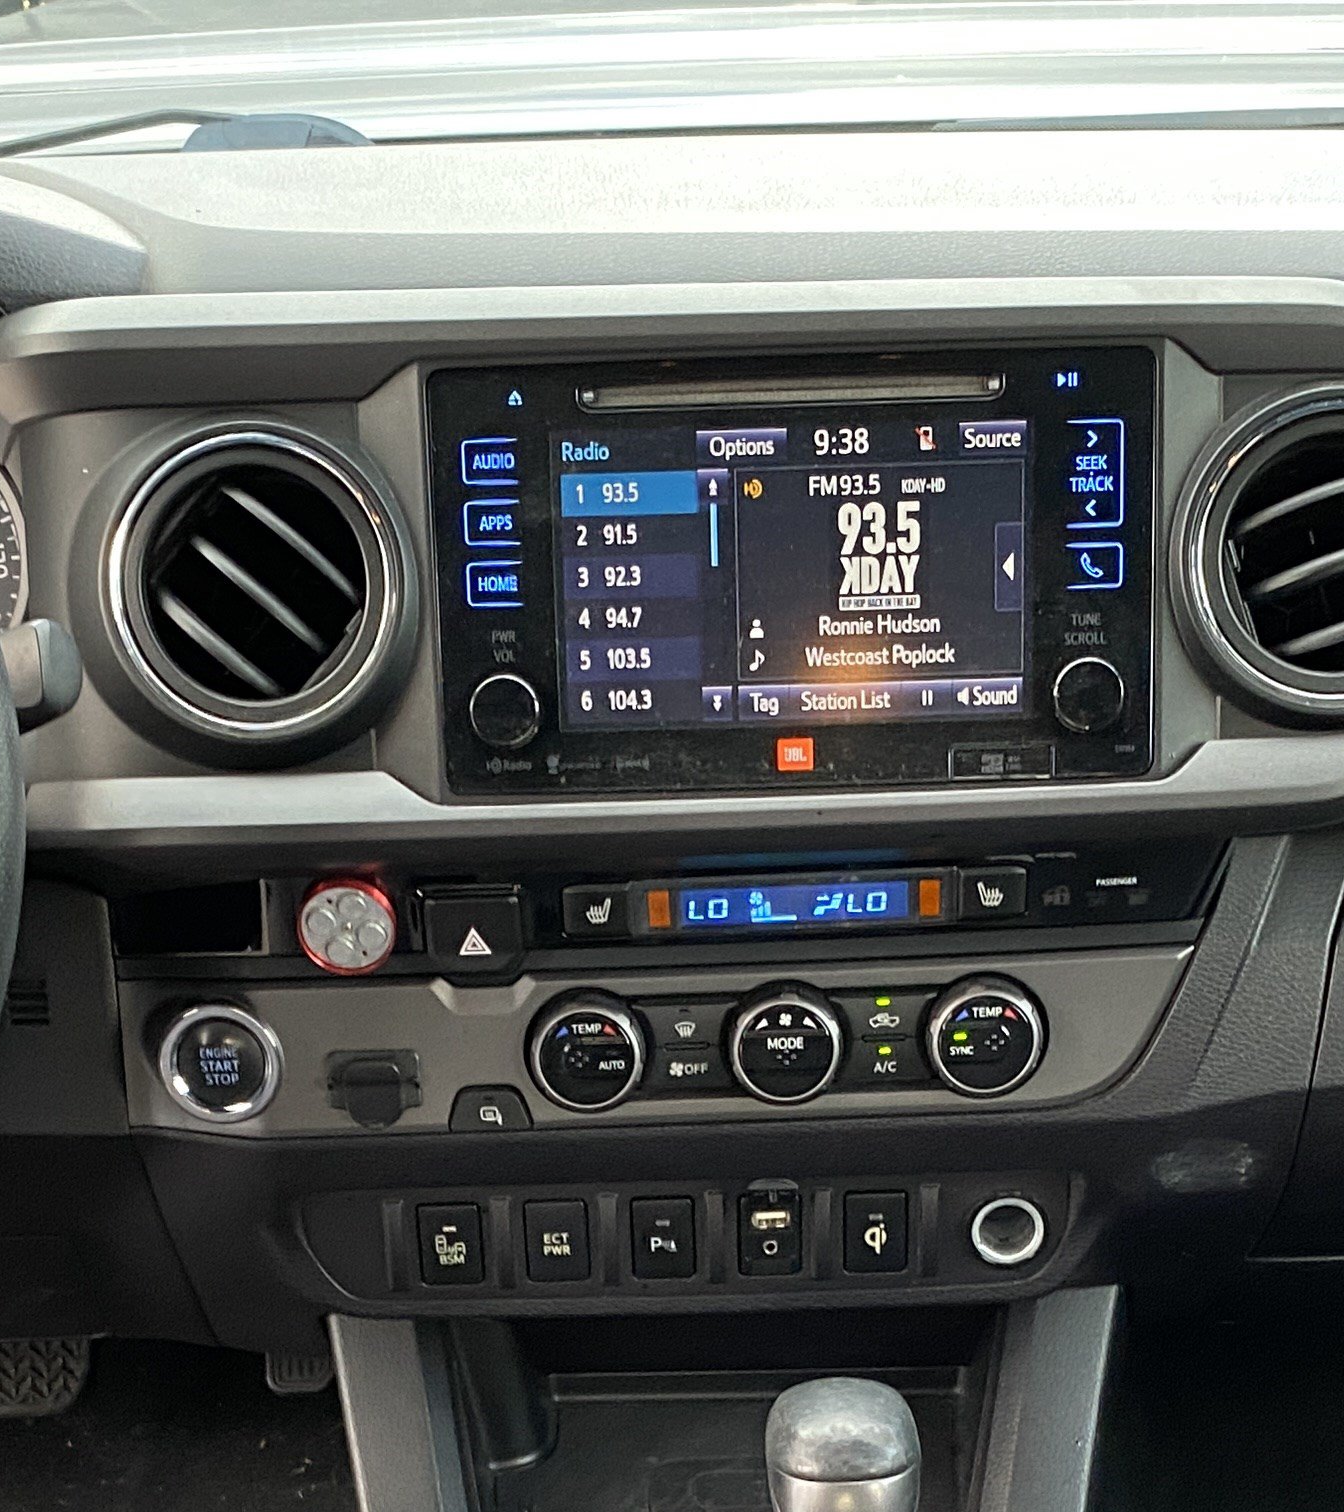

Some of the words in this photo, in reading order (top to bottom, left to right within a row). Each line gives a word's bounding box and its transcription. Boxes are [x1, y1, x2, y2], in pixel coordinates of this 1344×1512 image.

[813, 428, 870, 456] 9:38
[963, 427, 1022, 449] Source
[561, 441, 610, 462] Radio
[709, 436, 775, 461] Options
[472, 452, 516, 470] AUDIO
[1075, 455, 1108, 471] SEEK
[1069, 475, 1114, 492] TRACK
[575, 483, 585, 505] 1
[601, 482, 640, 503] 93.5
[479, 514, 513, 532] APPS
[837, 500, 922, 556] 93.5
[576, 525, 588, 547] 2
[602, 523, 638, 545] 91.5
[477, 574, 519, 592] HOME
[577, 566, 589, 588] 3
[604, 565, 642, 587] 92.3
[838, 554, 921, 596] KDAY
[578, 607, 591, 629] 4
[605, 606, 642, 629] 94.7
[818, 614, 874, 637] Ronnie
[876, 612, 941, 635] Hudson
[1071, 612, 1102, 627] TUNE
[1064, 631, 1107, 646] SCROLL
[492, 650, 517, 664] VOL
[579, 649, 592, 671] 5
[606, 647, 652, 669] 103.5
[804, 646, 890, 668] Westcoast
[892, 641, 956, 669] Poplock
[580, 690, 593, 712] 6
[607, 689, 653, 711] 104.3
[748, 692, 780, 716] Tag
[800, 690, 857, 712] Station
[860, 688, 892, 710] List
[972, 684, 1018, 706] Sound
[783, 746, 808, 763] JBL
[971, 1006, 1003, 1019] TEMP
[571, 1022, 603, 1035] TEMP
[766, 1036, 805, 1051] MODE
[949, 1045, 975, 1057] SYNC
[199, 1046, 239, 1060] ENGINE
[199, 1059, 240, 1073] START
[598, 1059, 626, 1071] AUTO
[684, 1062, 709, 1075] OFF
[873, 1060, 898, 1075] A/C
[205, 1072, 240, 1087] STOP
[543, 1231, 570, 1245] ECT
[439, 1253, 466, 1266] BSM
[543, 1244, 572, 1257] PWR
